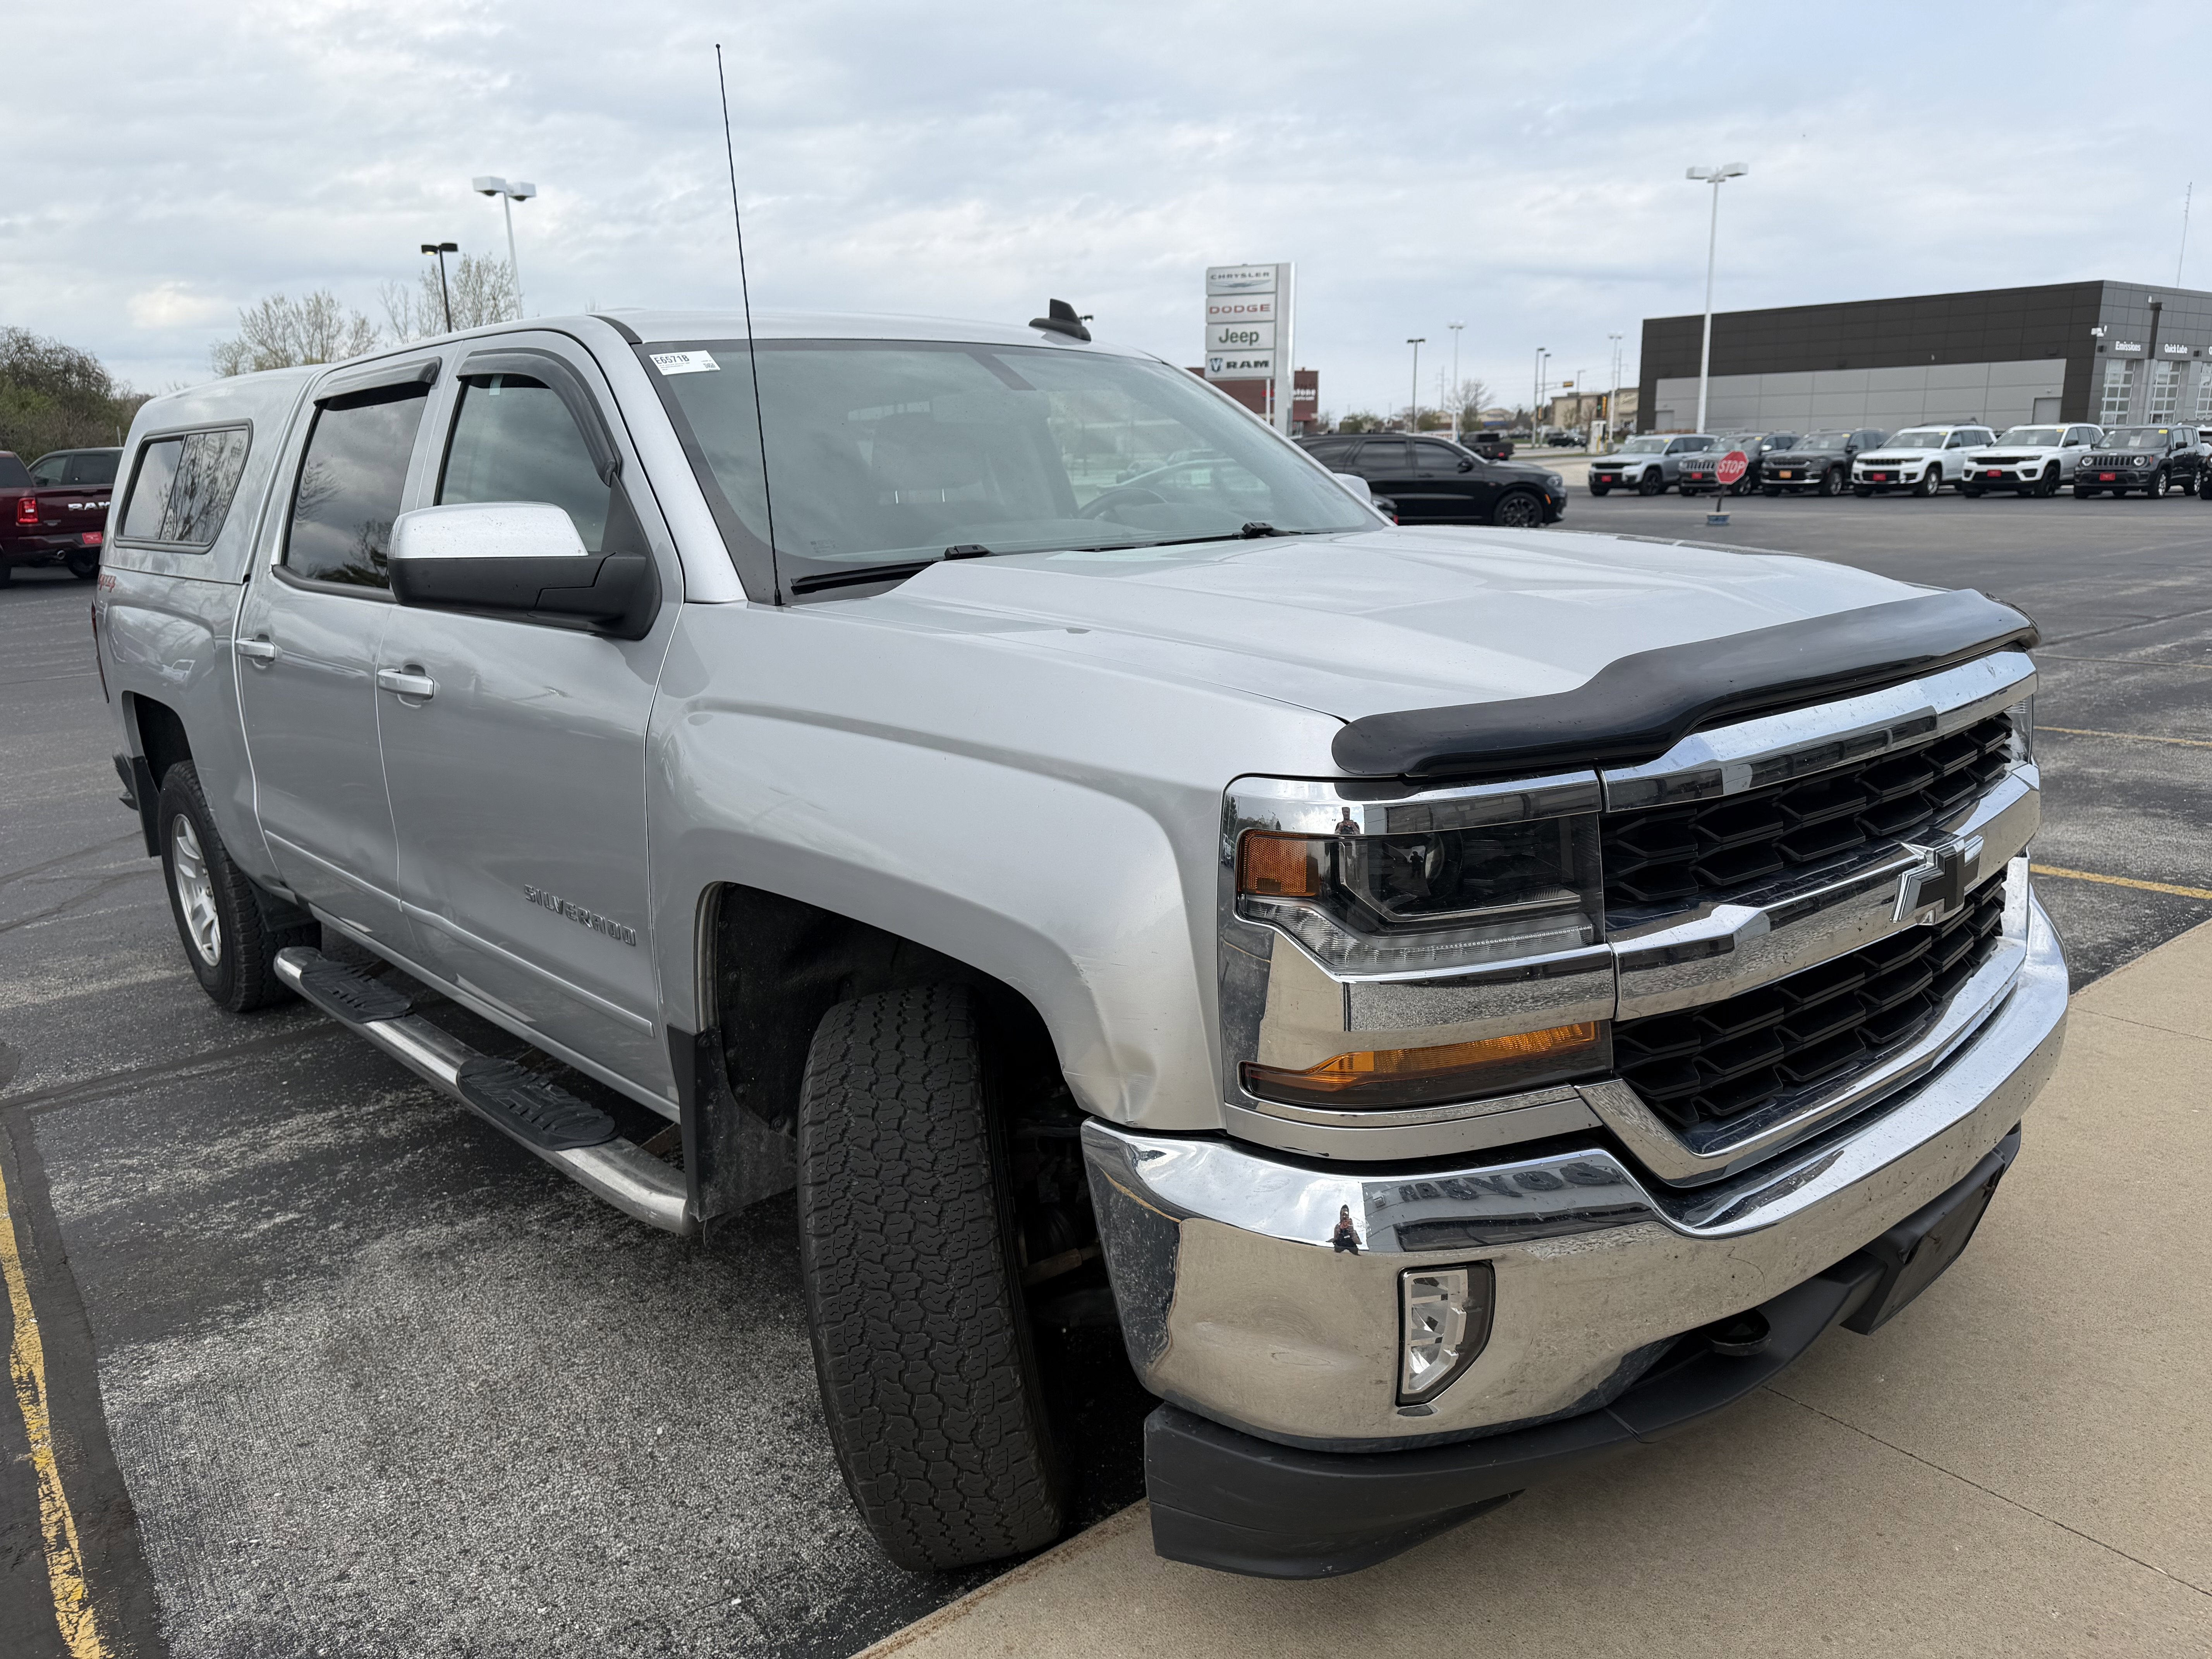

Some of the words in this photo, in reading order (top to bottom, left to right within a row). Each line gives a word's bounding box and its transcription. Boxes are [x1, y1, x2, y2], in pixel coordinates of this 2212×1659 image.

[1209, 304, 1271, 314] DODGE
[1219, 328, 1259, 345] Jeep
[2115, 341, 2141, 351] Emissions
[2164, 343, 2176, 353] Quick
[2177, 344, 2188, 354] Lube
[654, 355, 690, 364] E6571B
[1226, 360, 1270, 369] RAM
[1719, 459, 1745, 474] STOP
[524, 884, 636, 946] SILVERADO
